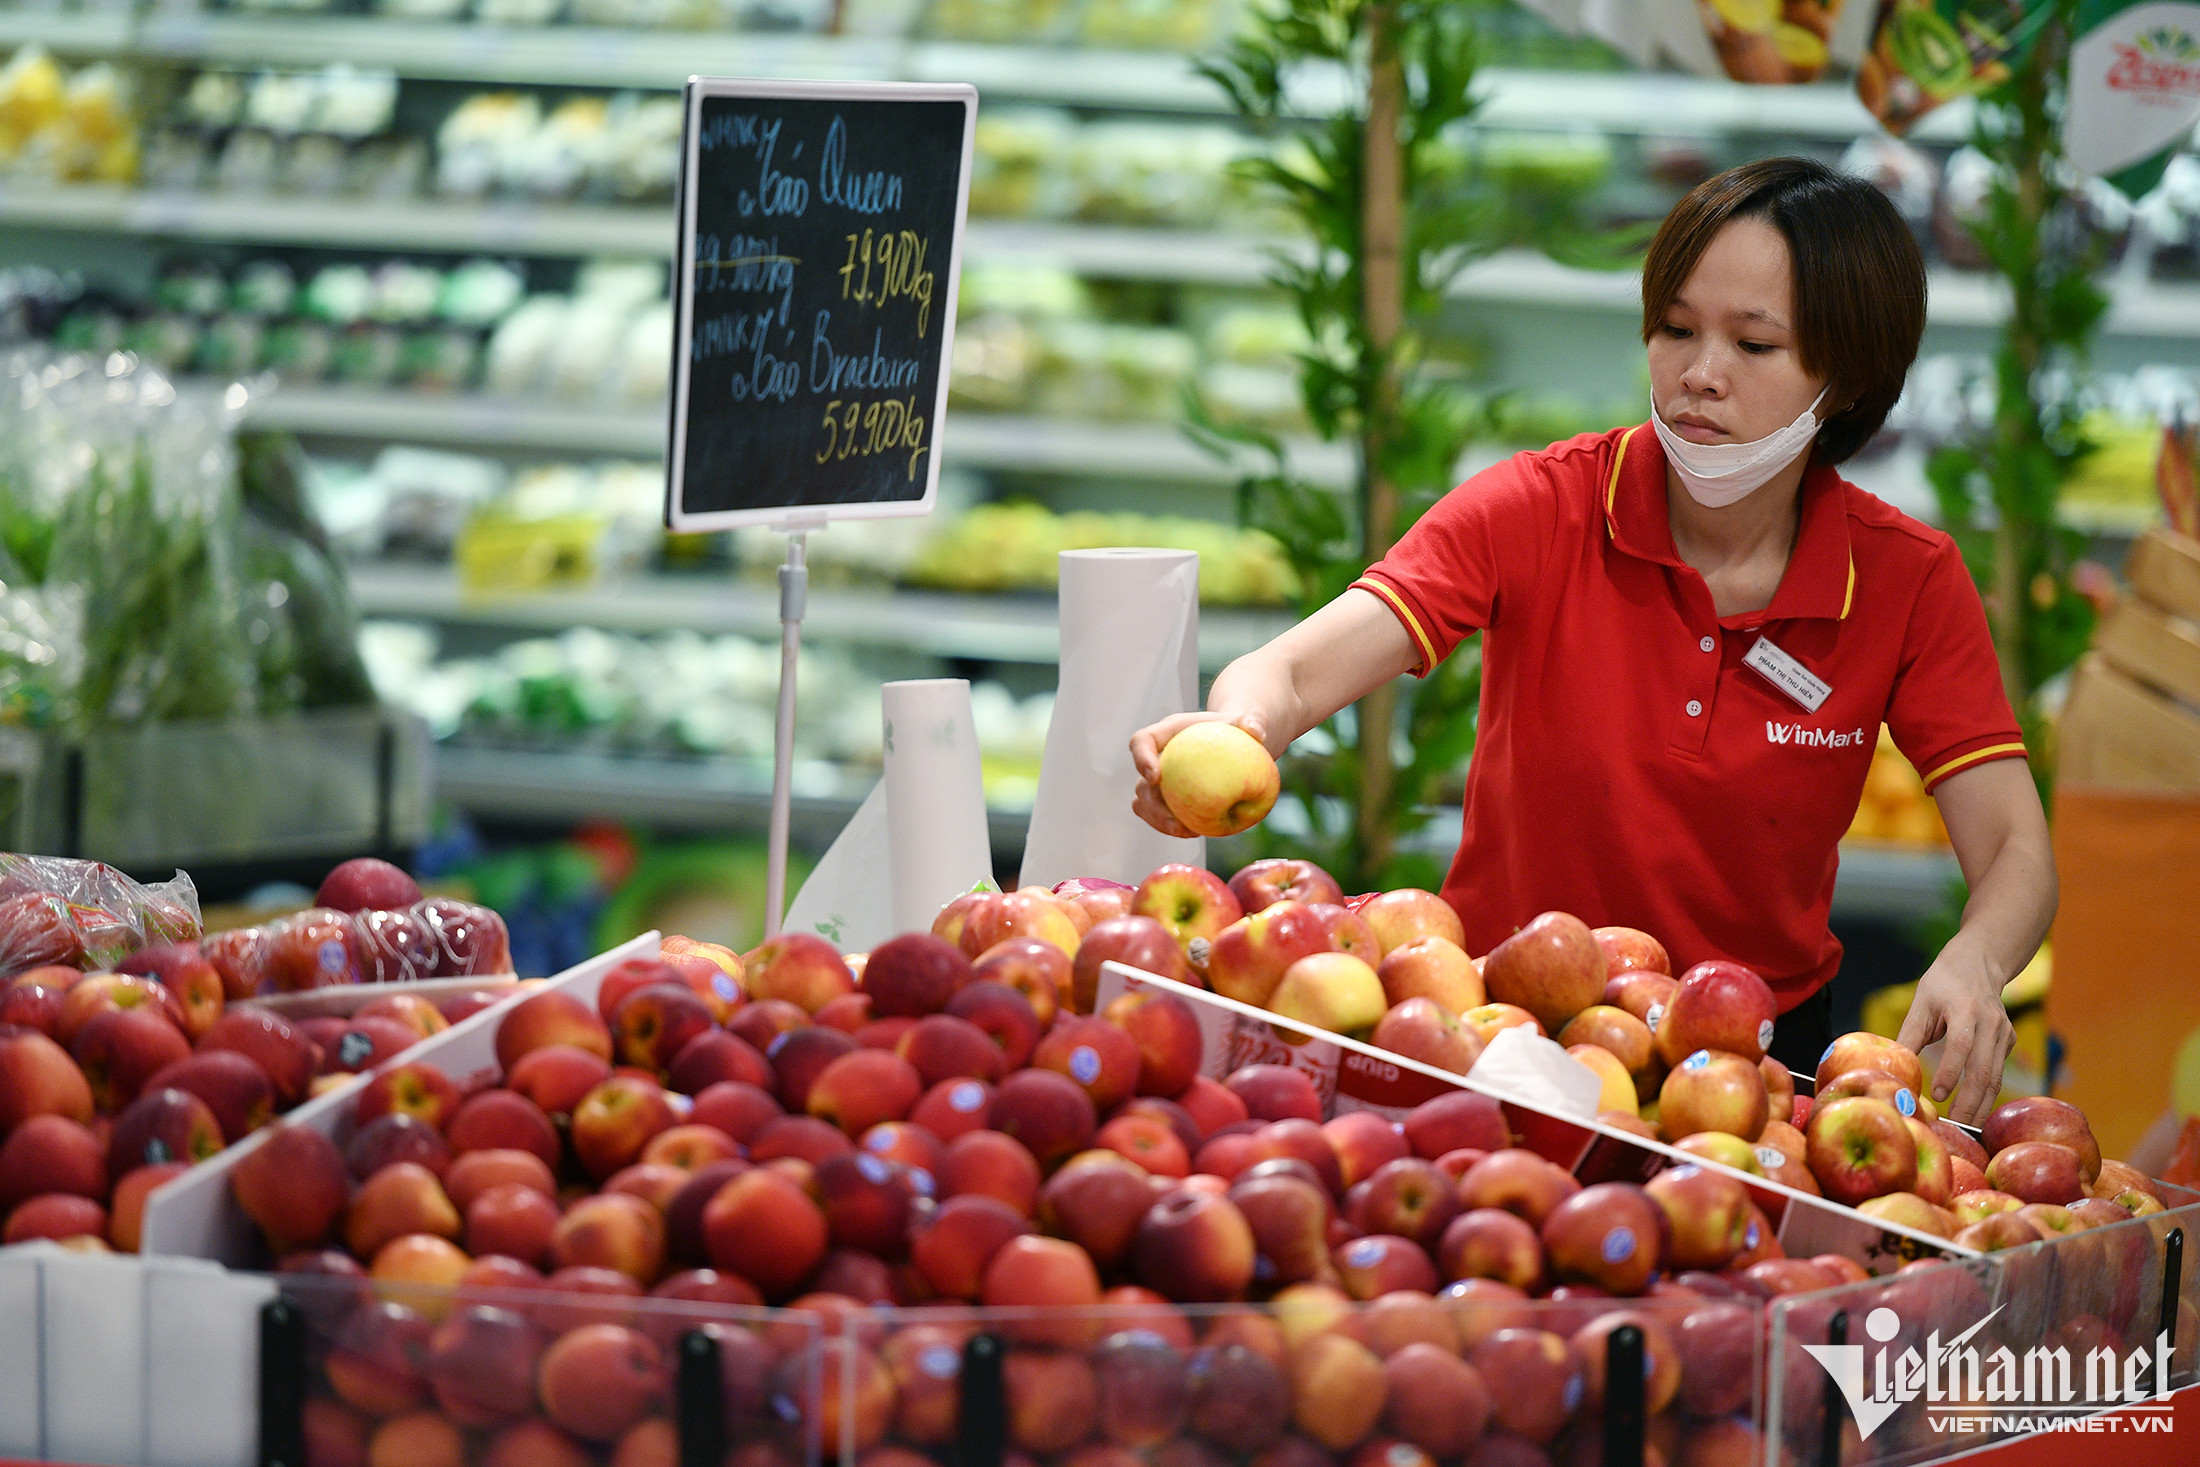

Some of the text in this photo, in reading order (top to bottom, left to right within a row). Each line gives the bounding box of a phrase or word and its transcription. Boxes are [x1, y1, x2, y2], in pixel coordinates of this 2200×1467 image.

[820, 115, 902, 214] Queen
[811, 310, 919, 394] Braeburn
[816, 396, 928, 482] 59.900kg
[1786, 677, 1799, 689] THU
[1766, 720, 1864, 748] WinMart
